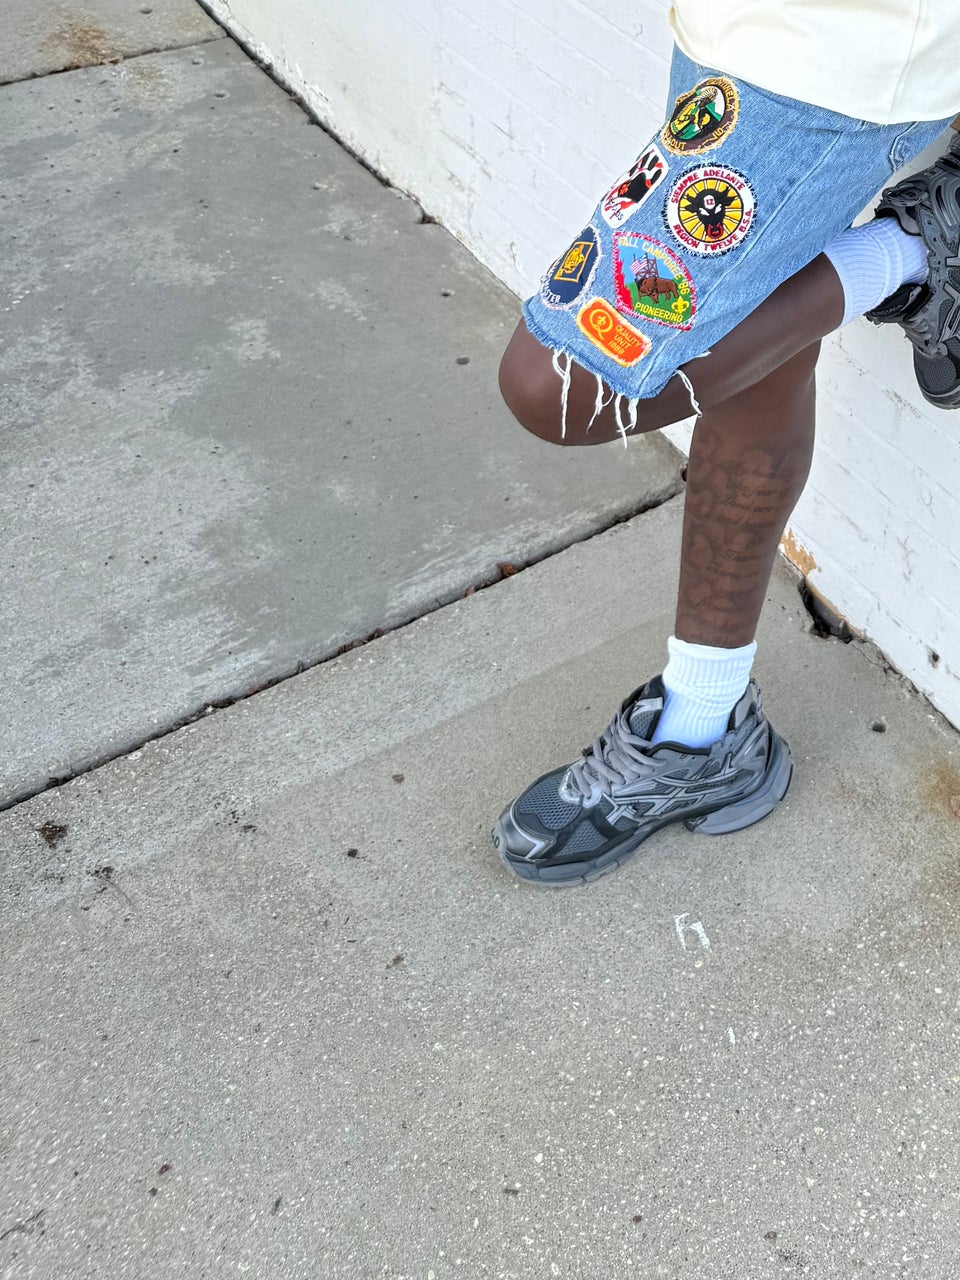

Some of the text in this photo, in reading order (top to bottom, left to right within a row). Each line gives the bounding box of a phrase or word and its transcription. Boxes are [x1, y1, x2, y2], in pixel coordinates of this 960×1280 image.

[671, 169, 746, 204] SIEMPRE ADELANTE
[673, 224, 700, 249] REGION
[704, 233, 739, 251] TWELVE
[618, 237, 639, 249] FALL
[641, 241, 686, 280] CAMPOREE
[634, 302, 684, 323] PIONEERING
[613, 334, 631, 349] UNIT
[615, 324, 641, 347] QUALITY
